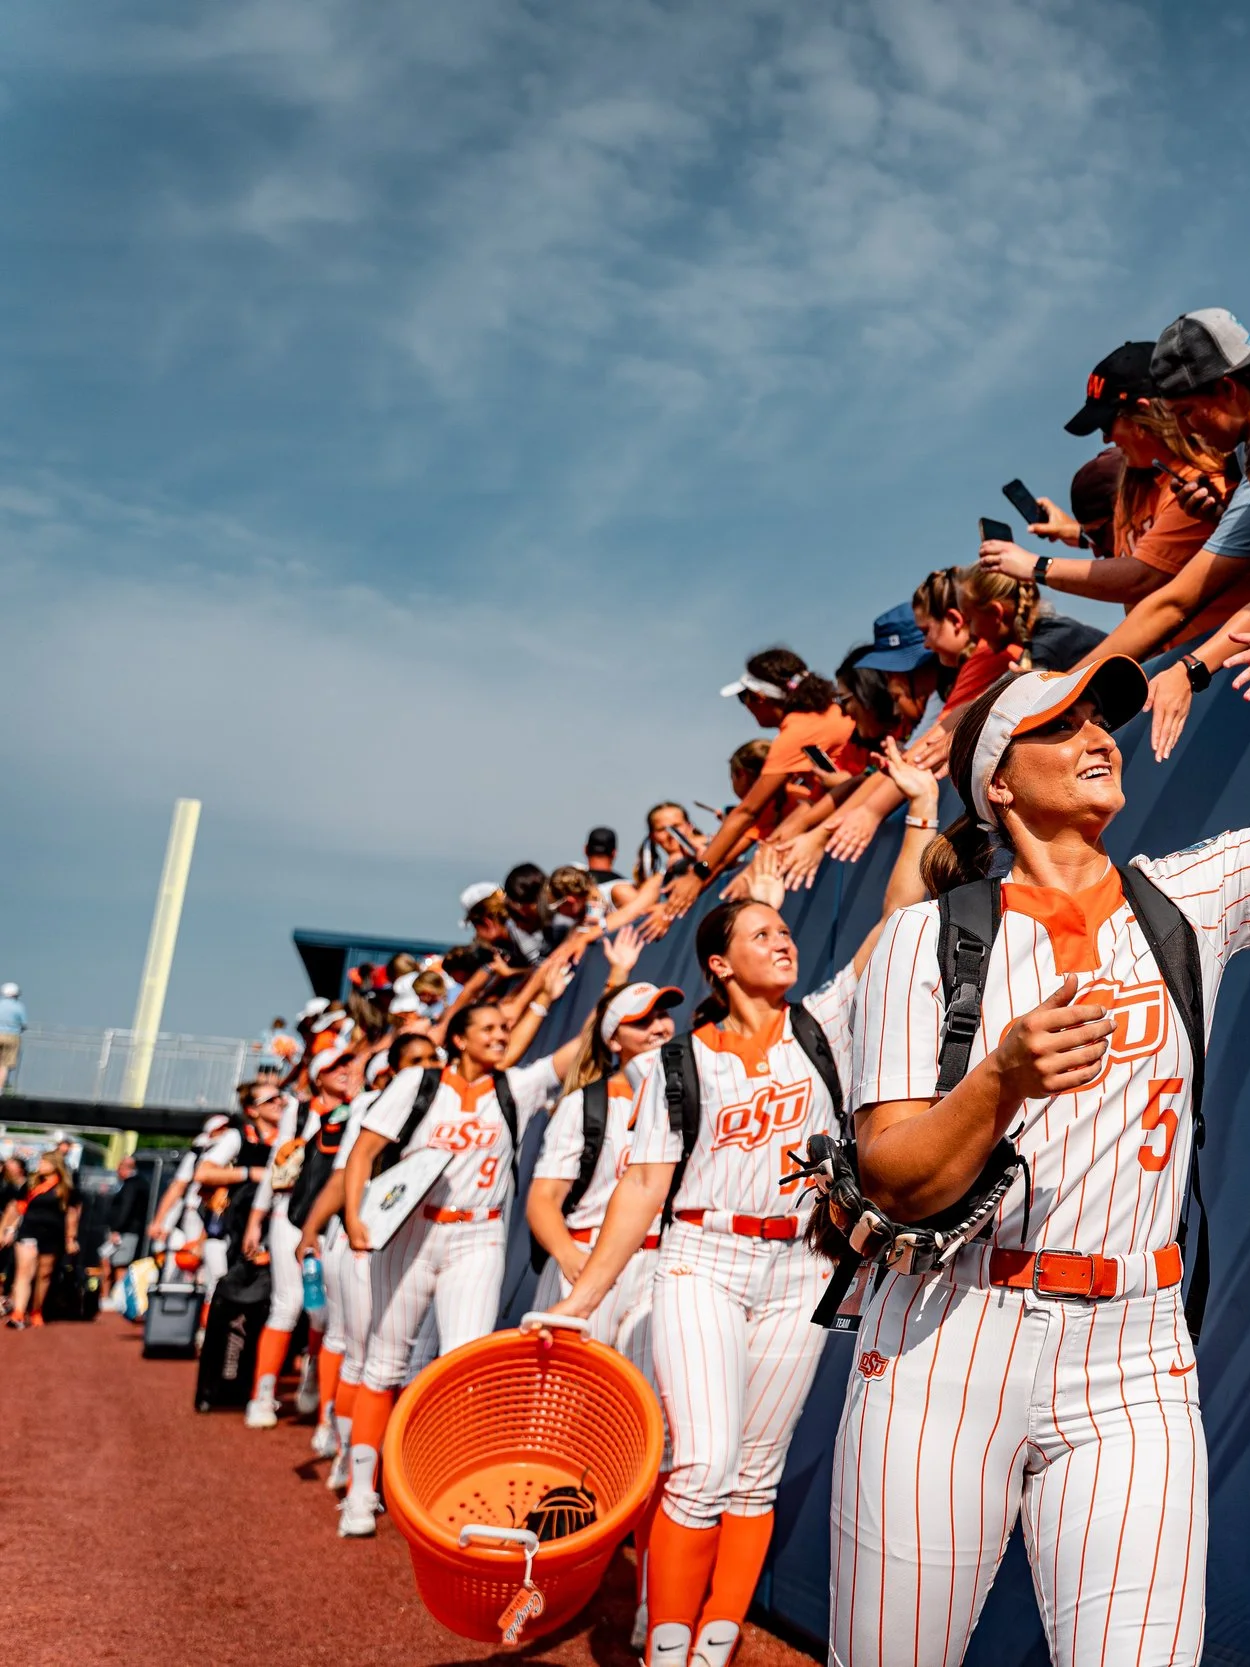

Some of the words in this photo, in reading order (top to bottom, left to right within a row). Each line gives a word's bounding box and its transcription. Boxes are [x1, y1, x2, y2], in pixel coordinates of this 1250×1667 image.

[712, 1078, 812, 1152] OSU
[1138, 1078, 1184, 1172] 5
[428, 1118, 501, 1152] OSU
[477, 1156, 498, 1188] 9
[835, 1317, 851, 1329] TEAM
[858, 1350, 889, 1379] OSU
